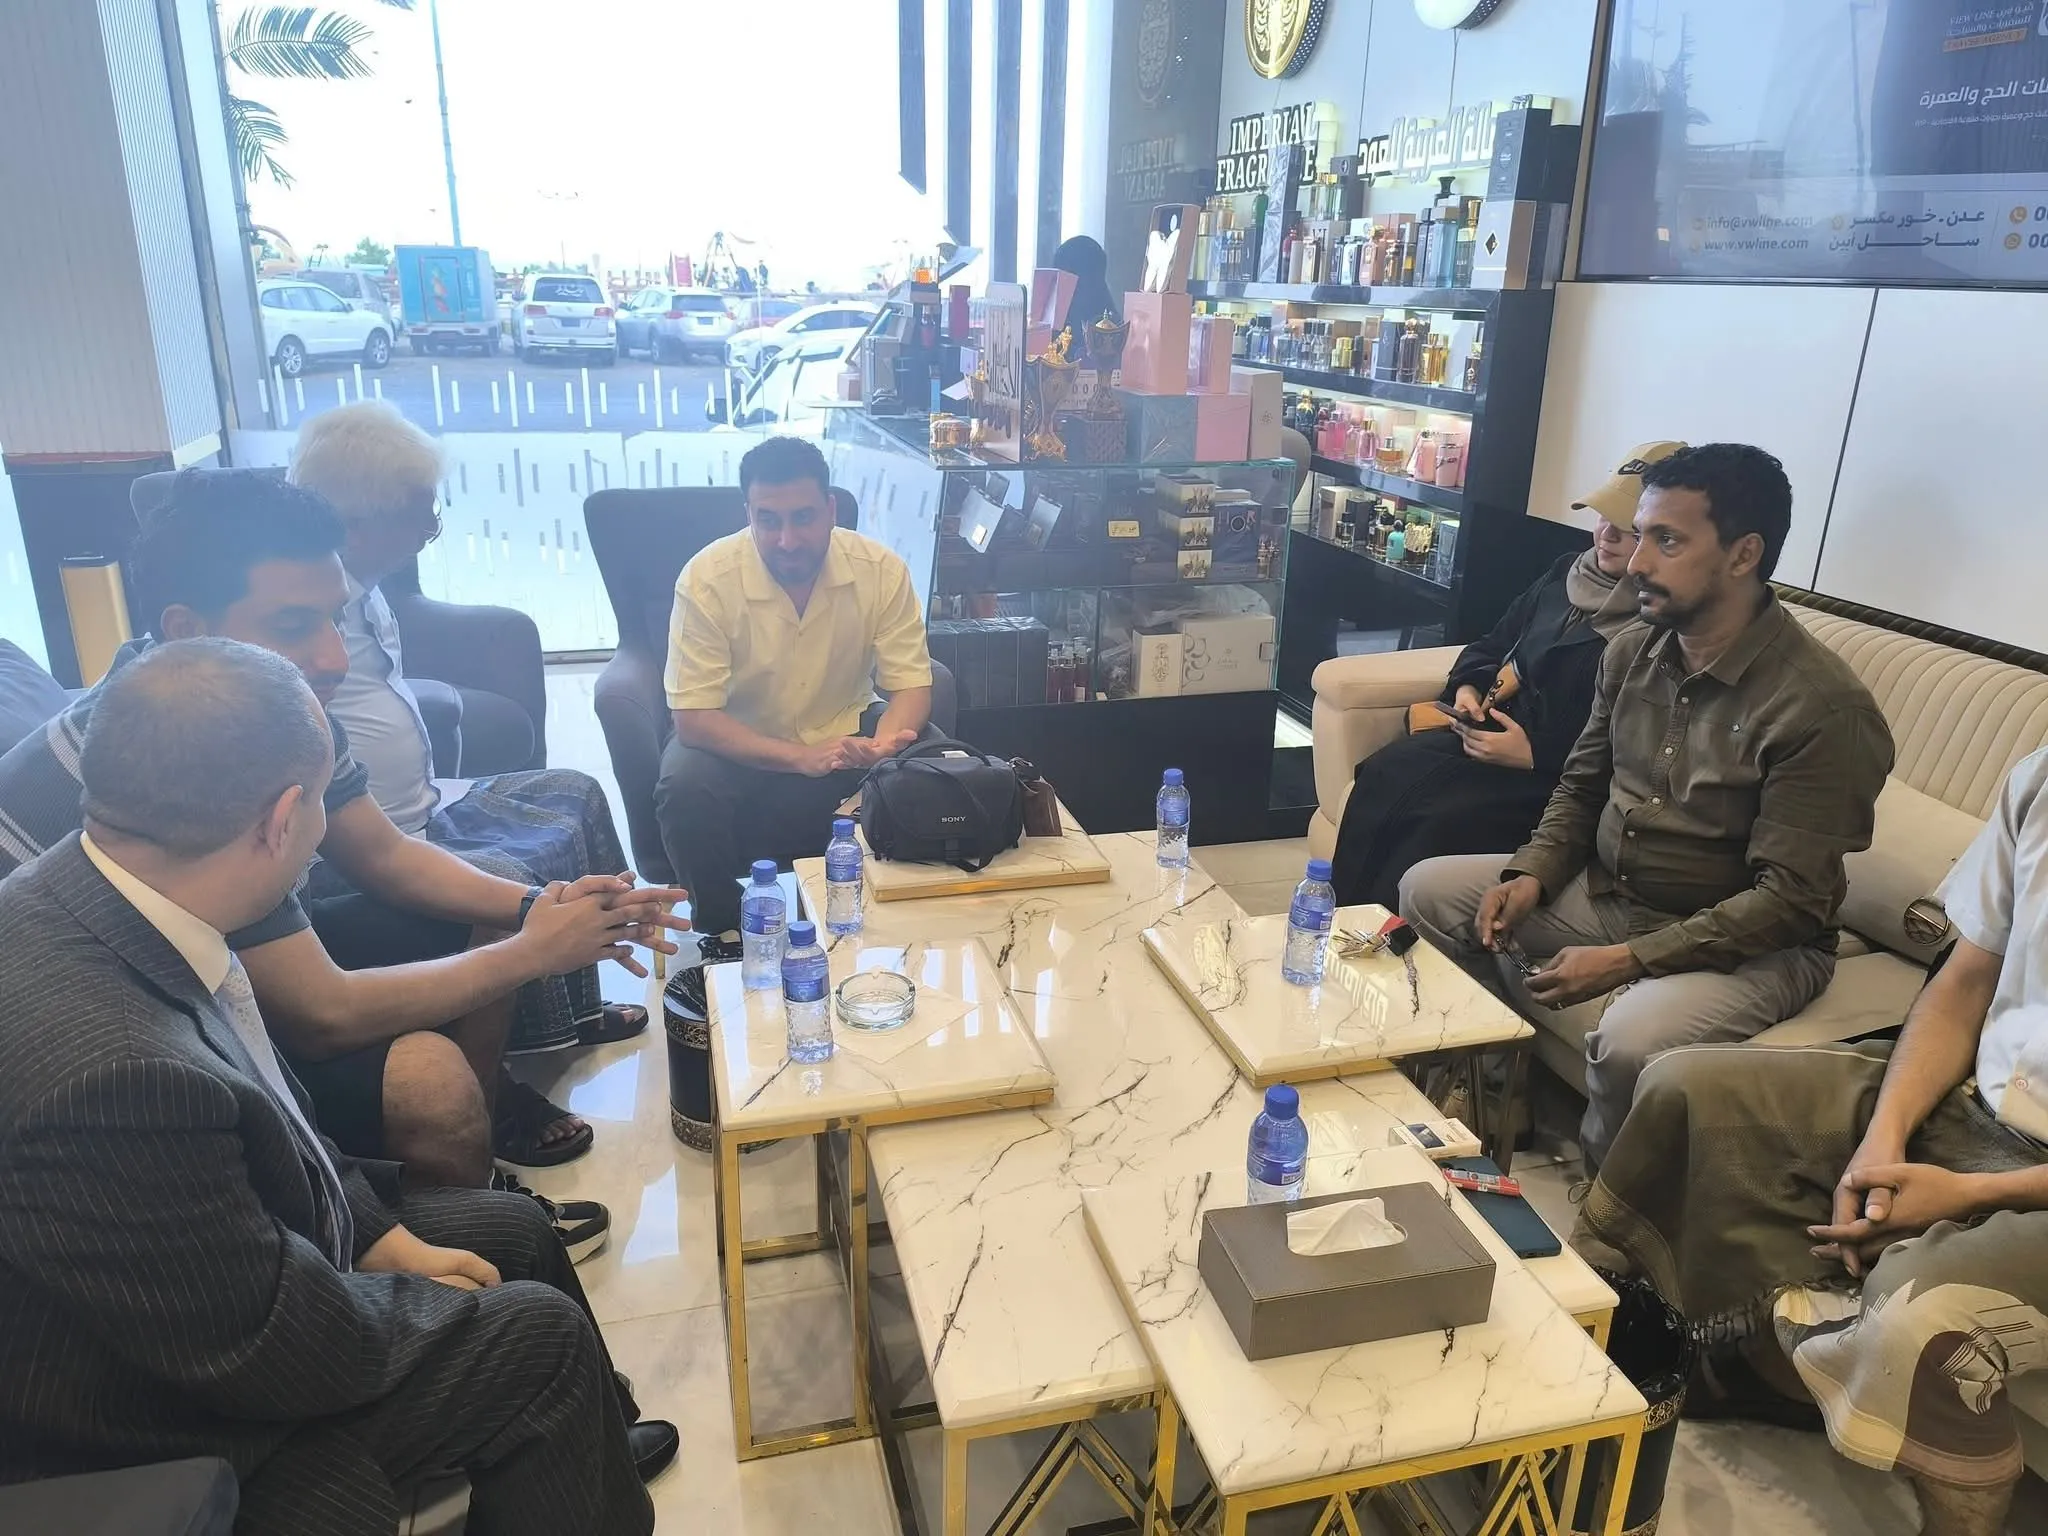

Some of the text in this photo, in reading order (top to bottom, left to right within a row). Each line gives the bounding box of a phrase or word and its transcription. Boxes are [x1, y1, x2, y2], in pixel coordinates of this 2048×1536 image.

[1920, 86, 1979, 109] والعمرة
[1981, 80, 2018, 105] الحج
[1230, 103, 1318, 155] IMPERIAL
[1216, 146, 1316, 192] FRAGRE
[1707, 214, 1813, 231] info@vwline.com
[1849, 211, 1895, 229] مكسر
[1897, 208, 1936, 229] خور
[1946, 209, 1985, 226] عدن
[1704, 238, 1809, 250] www.vwline.com
[1857, 232, 1980, 250] ساحل
